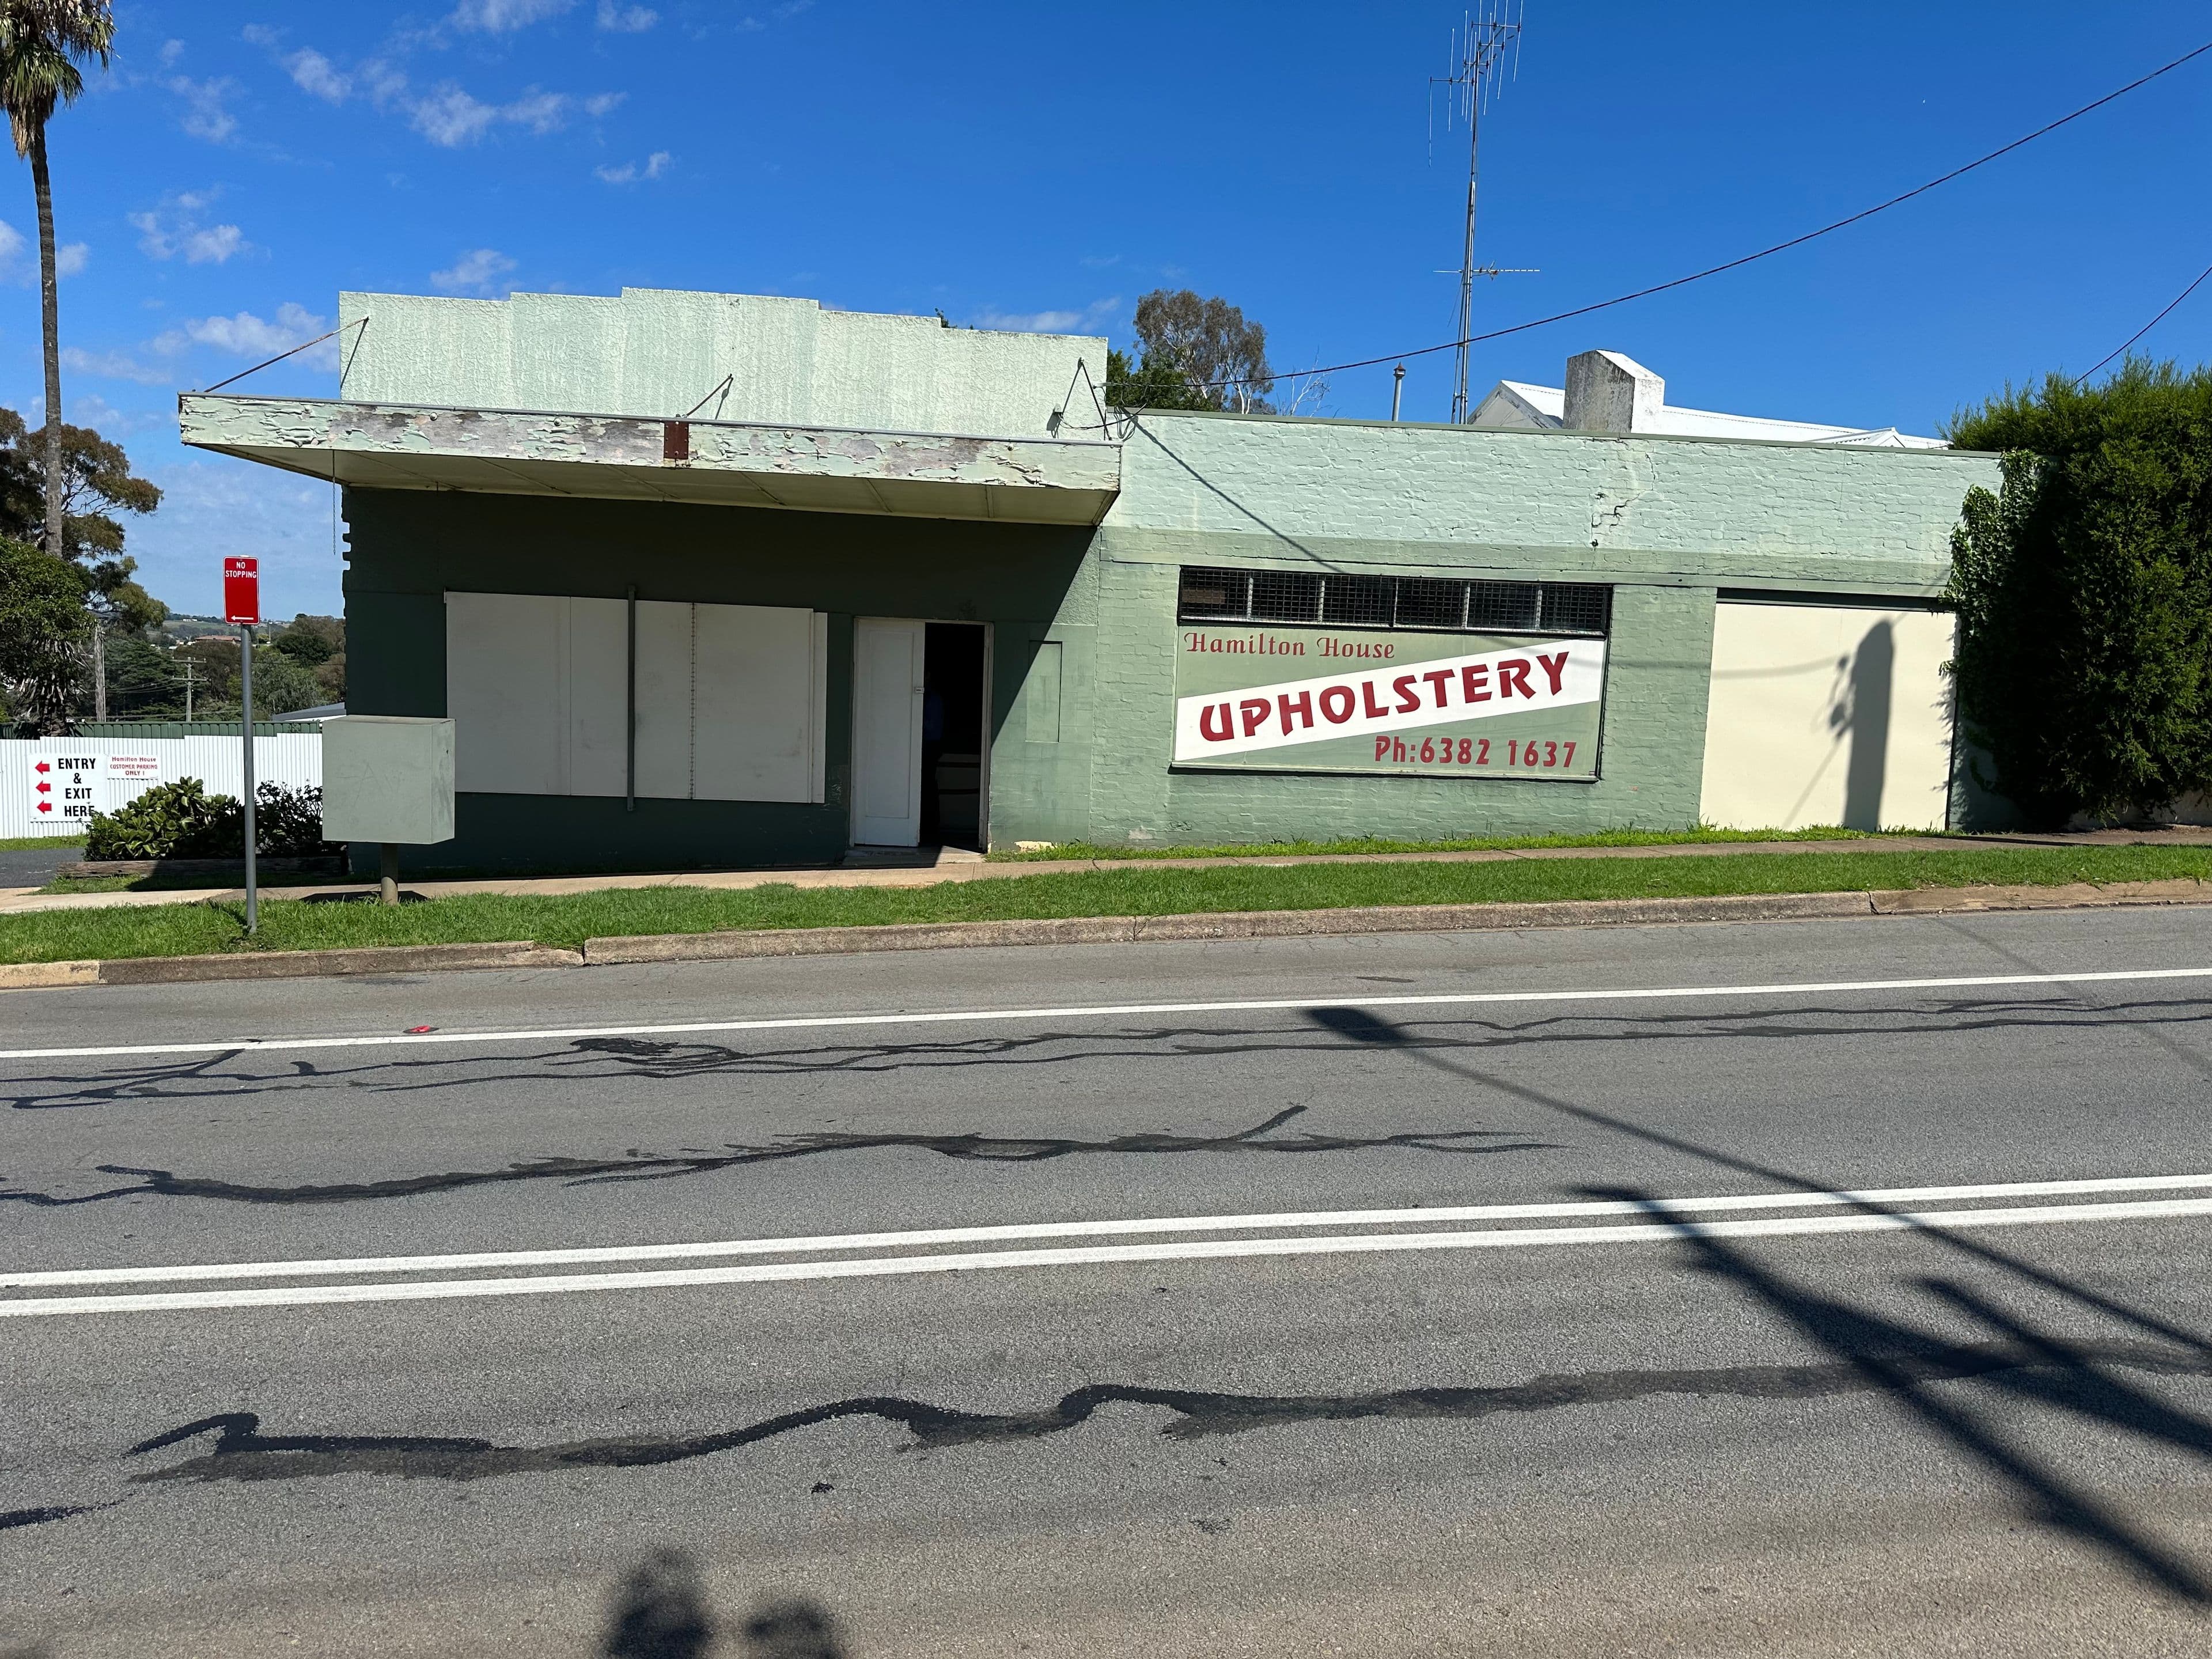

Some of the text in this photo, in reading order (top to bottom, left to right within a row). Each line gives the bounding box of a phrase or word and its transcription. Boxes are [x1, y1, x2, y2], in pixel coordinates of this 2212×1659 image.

[225, 570, 257, 578] STOPPING
[1184, 632, 1395, 659] Hamilton House
[1200, 652, 1570, 742] UPHOLSTERY
[1509, 740, 1577, 768] 1637
[58, 758, 96, 769] ENTRY
[73, 772, 82, 784] &
[65, 788, 92, 799] EXIT
[65, 806, 94, 817] HERE
